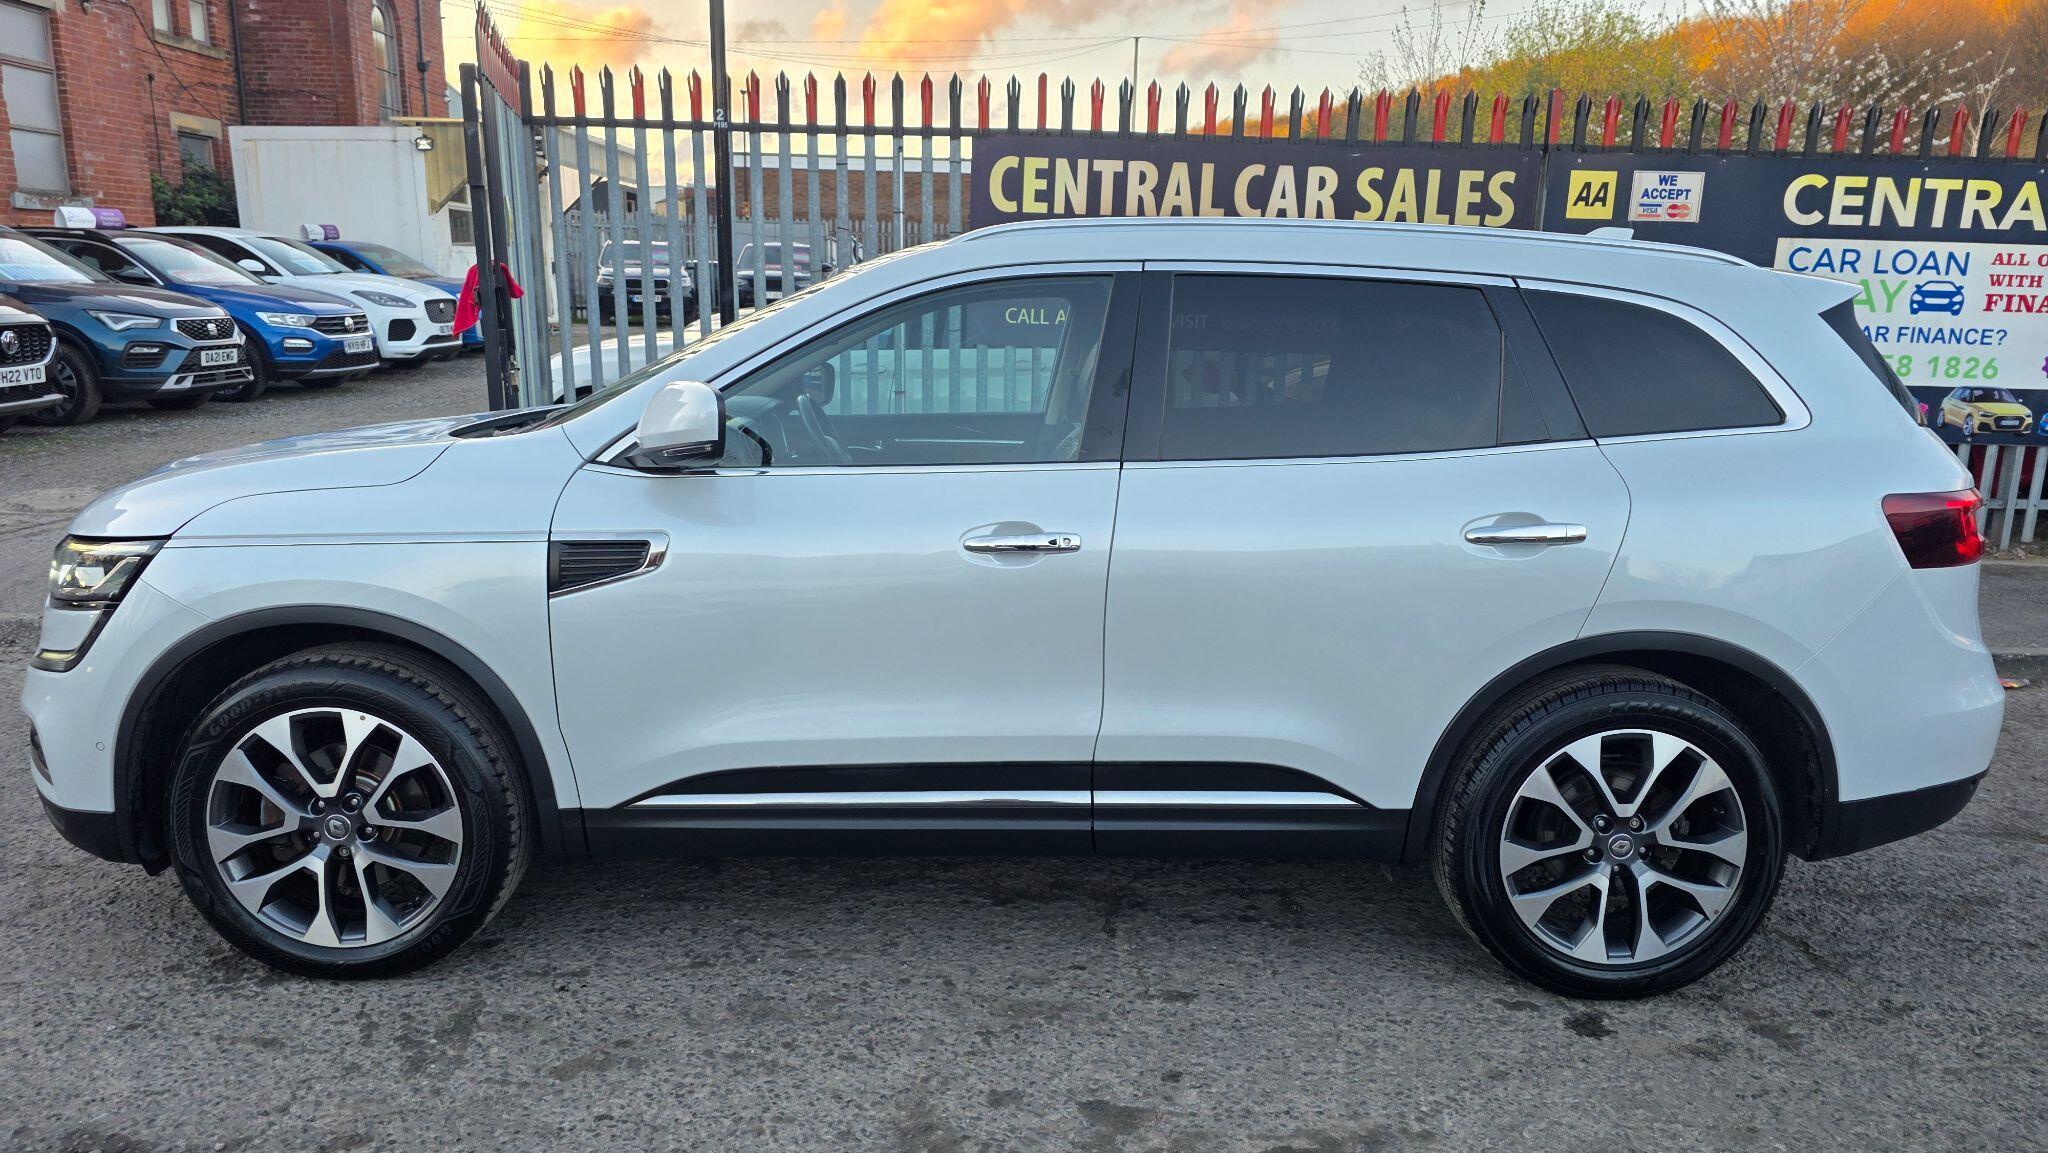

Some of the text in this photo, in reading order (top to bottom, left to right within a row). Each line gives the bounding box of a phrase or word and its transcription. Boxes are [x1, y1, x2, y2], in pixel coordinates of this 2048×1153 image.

[716, 108, 724, 121] 2
[1658, 174, 1678, 186] WE
[989, 156, 1517, 227] CENTRAL CAR SALES
[1573, 182, 1609, 206] AA
[1641, 188, 1691, 200] ACCEPT
[1783, 174, 2048, 231] CENTRA
[1788, 247, 1970, 276] CAR LOAN
[1990, 252, 2030, 266] ALL
[1989, 274, 2044, 288] WITH
[1983, 293, 2048, 313] FINA
[1005, 307, 1049, 325] CALL
[1896, 326, 2008, 346] FINANCE?
[23, 367, 42, 381] VTO
[1882, 355, 1999, 380] 8 1826
